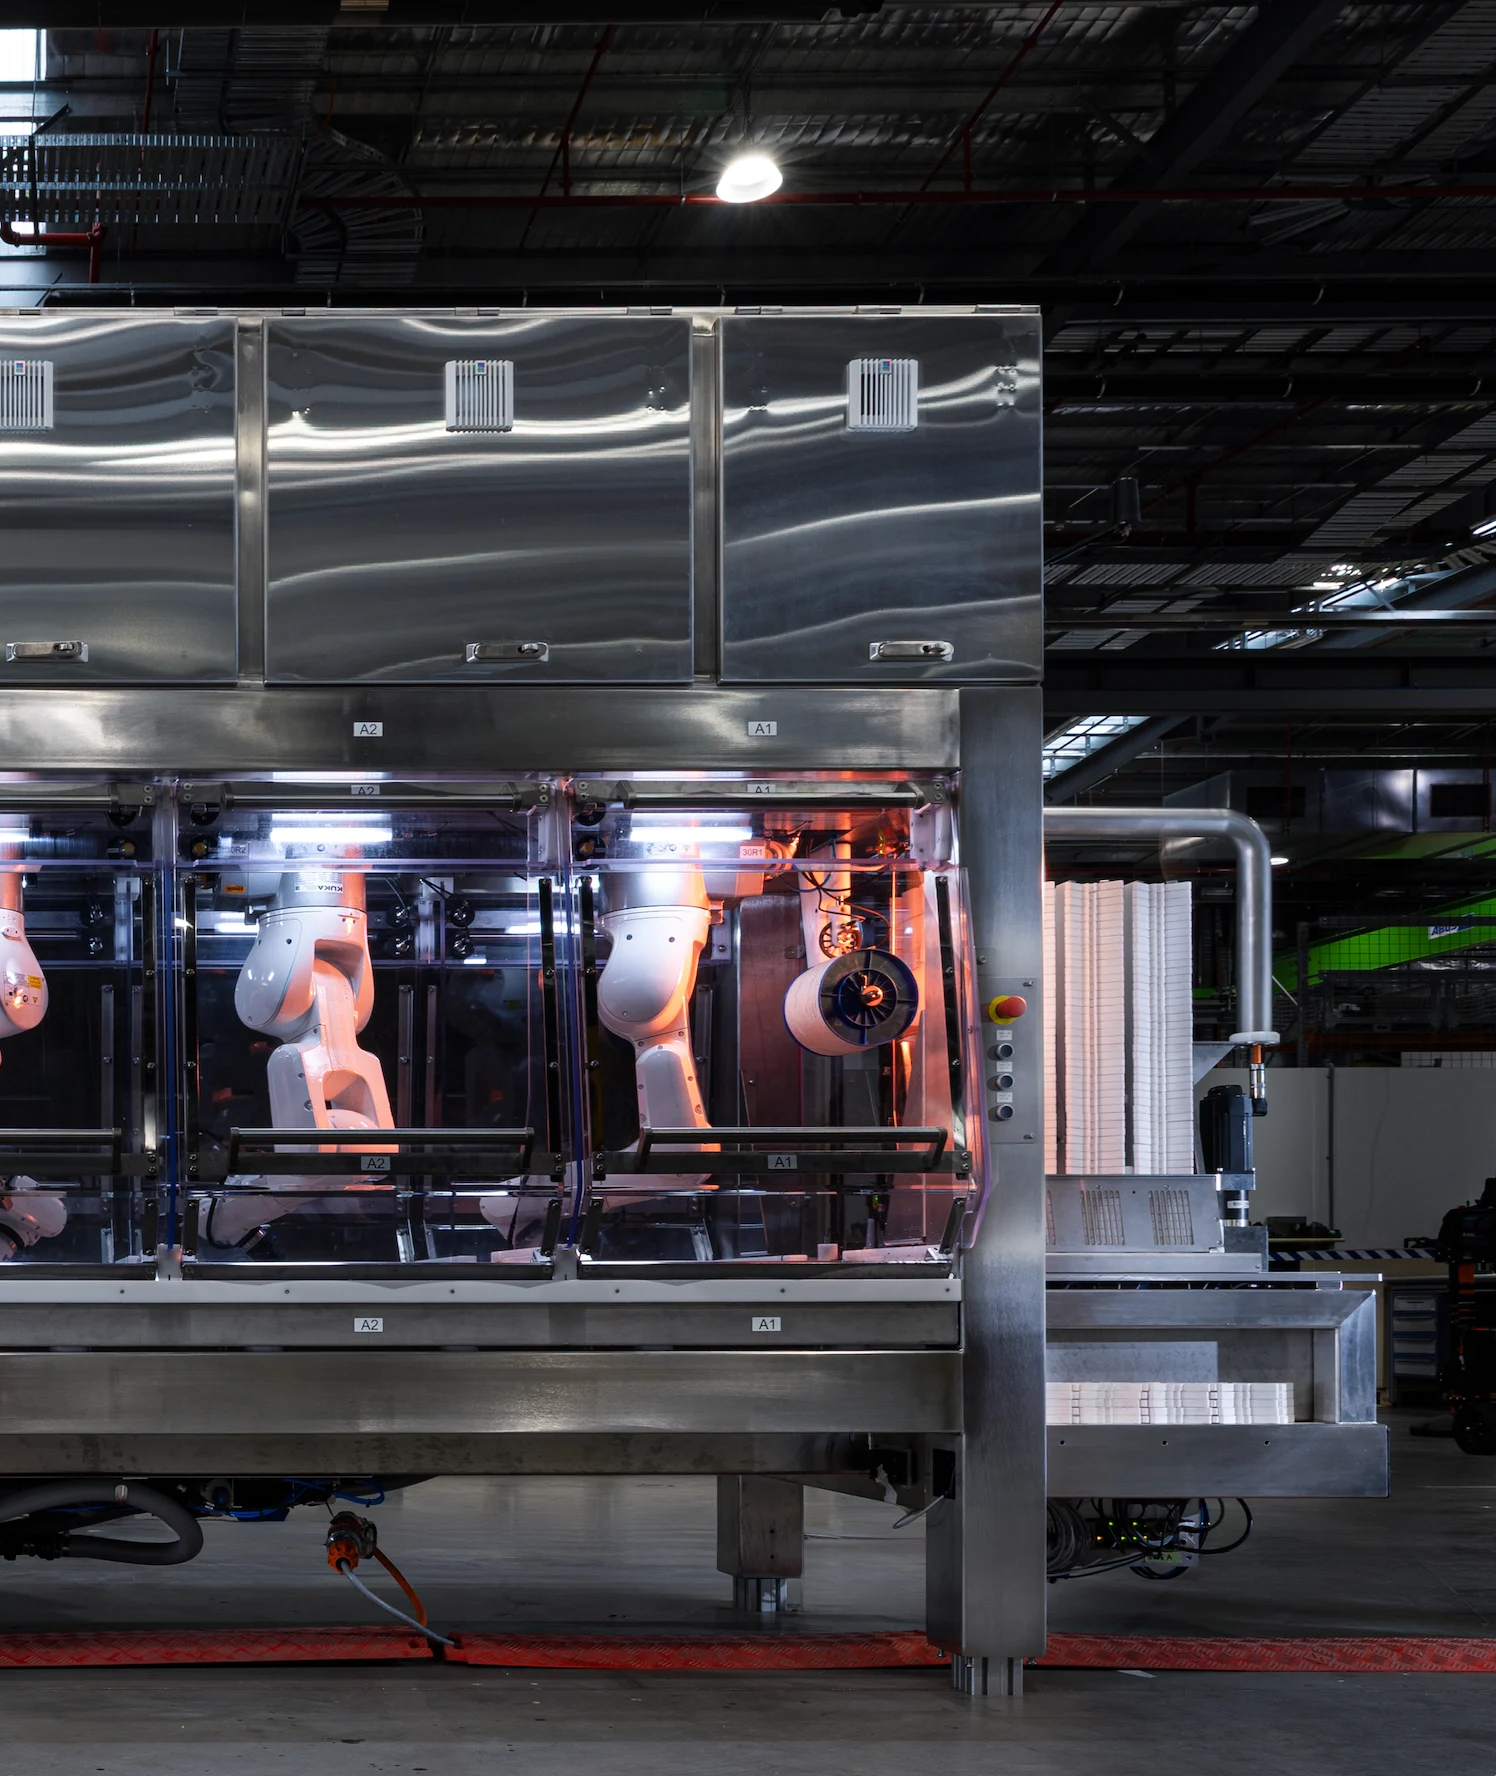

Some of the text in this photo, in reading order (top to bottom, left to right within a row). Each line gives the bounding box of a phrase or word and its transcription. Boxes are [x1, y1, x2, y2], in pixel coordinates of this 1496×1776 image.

[359, 723, 378, 735] A2
[754, 723, 771, 734] A1
[357, 786, 375, 795] A2
[755, 785, 770, 793] A1
[226, 846, 247, 854] 0R2
[742, 848, 763, 856] 30R1
[367, 1157, 385, 1169] A2
[774, 1156, 791, 1168] A1
[360, 1319, 379, 1331] A2
[758, 1318, 776, 1330] A1
